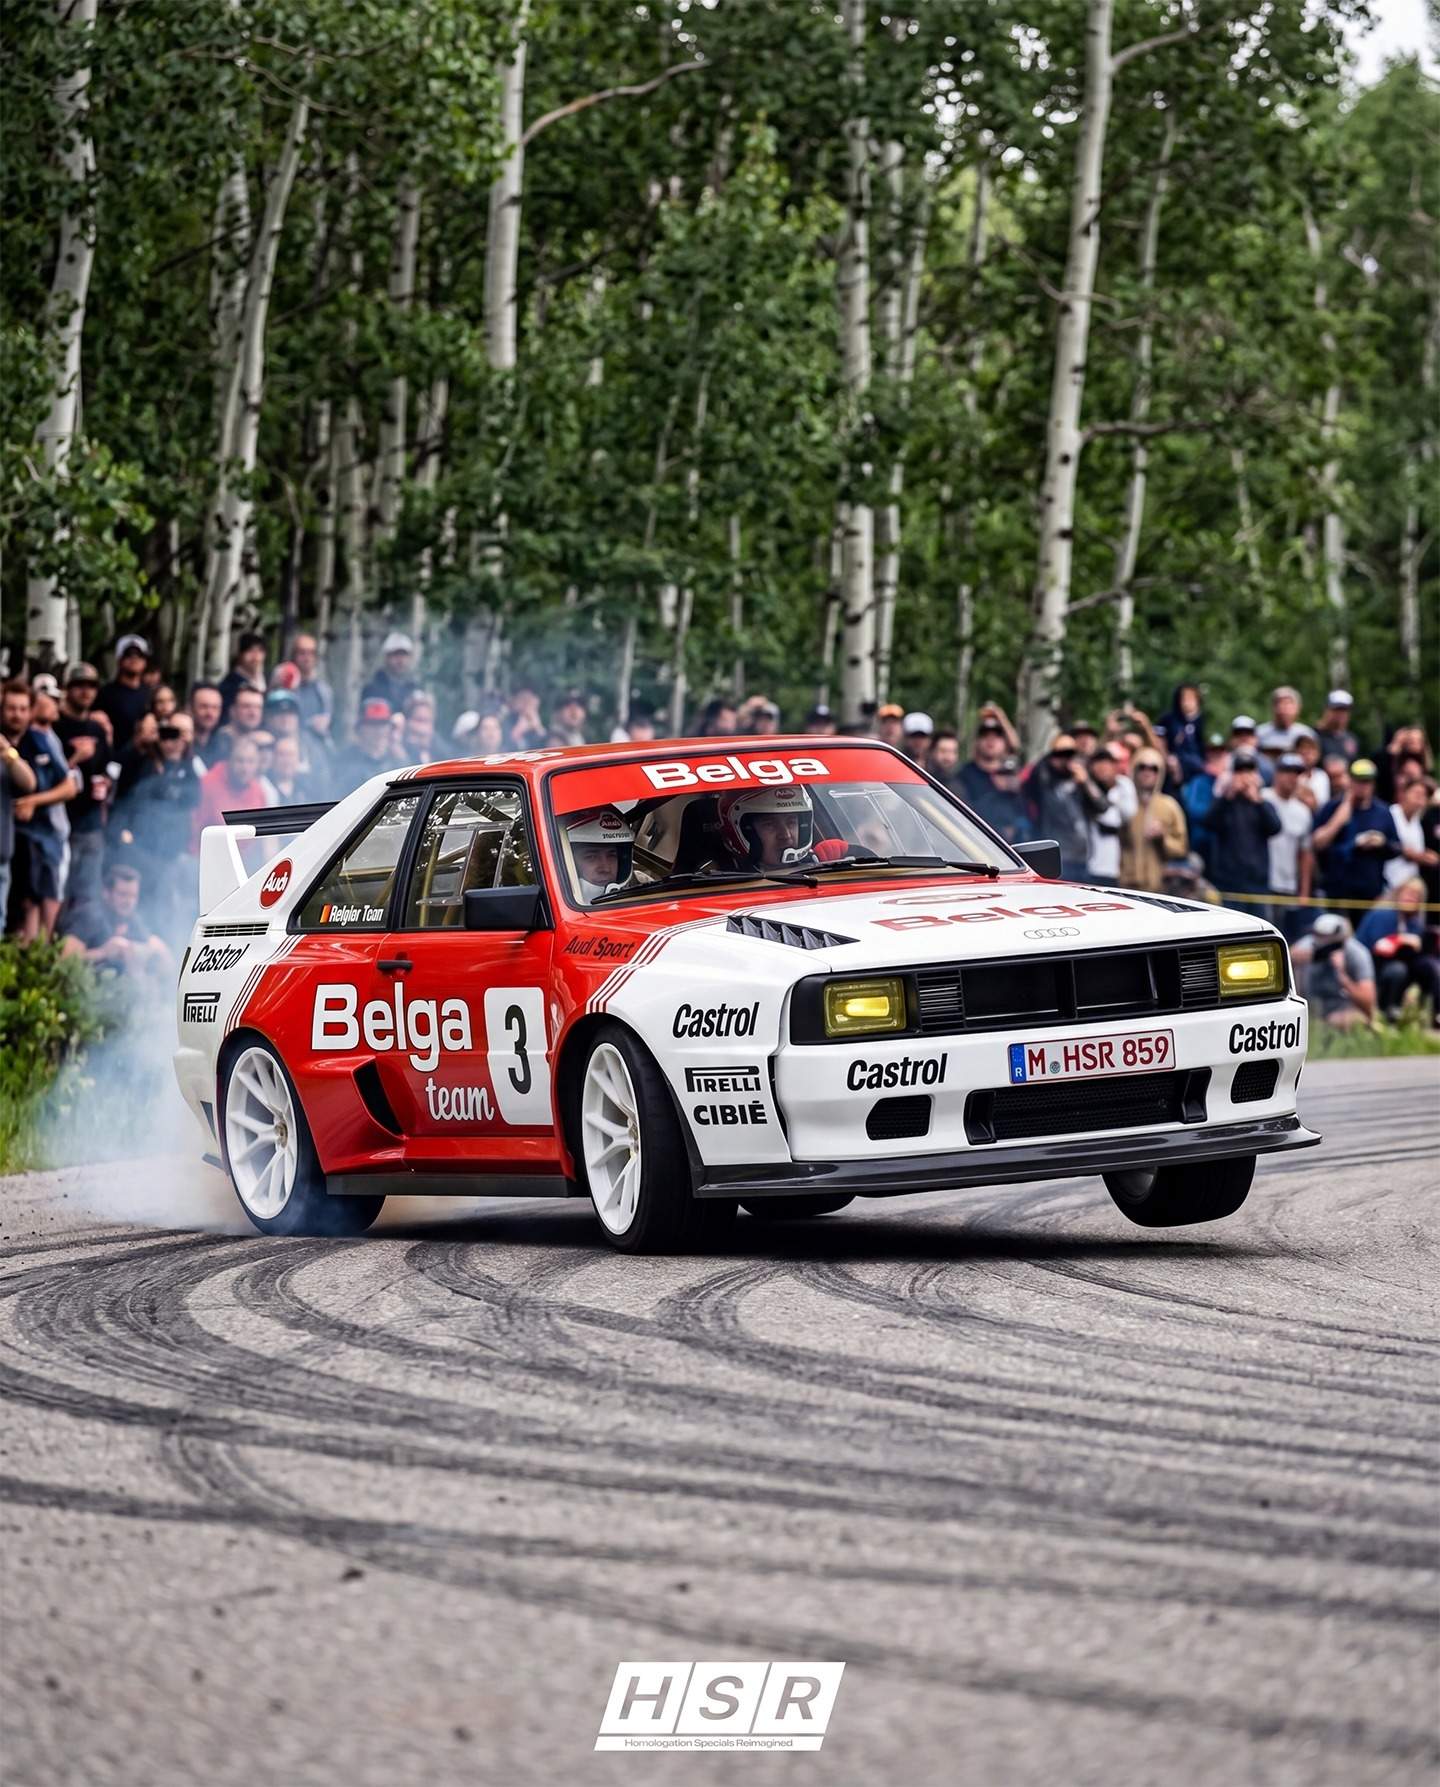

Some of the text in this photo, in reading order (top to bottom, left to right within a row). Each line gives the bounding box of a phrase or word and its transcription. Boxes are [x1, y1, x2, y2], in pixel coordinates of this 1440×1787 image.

[642, 756, 831, 790] Belga
[263, 875, 289, 893] Audi
[869, 902, 1135, 931] Belga
[191, 943, 250, 974] Castrol
[564, 935, 635, 960] Audi Sport
[183, 992, 221, 1023] PIRELLI
[672, 1001, 760, 1039] Castrol
[311, 981, 473, 1073] Belga
[1229, 1016, 1301, 1055] Castrol
[504, 1004, 532, 1095] 3
[1028, 1036, 1169, 1076] M HSR 859
[684, 1066, 762, 1092] PIRELLI
[847, 1053, 948, 1091] Castrol
[1015, 1066, 1023, 1078] R
[425, 1077, 495, 1122] team
